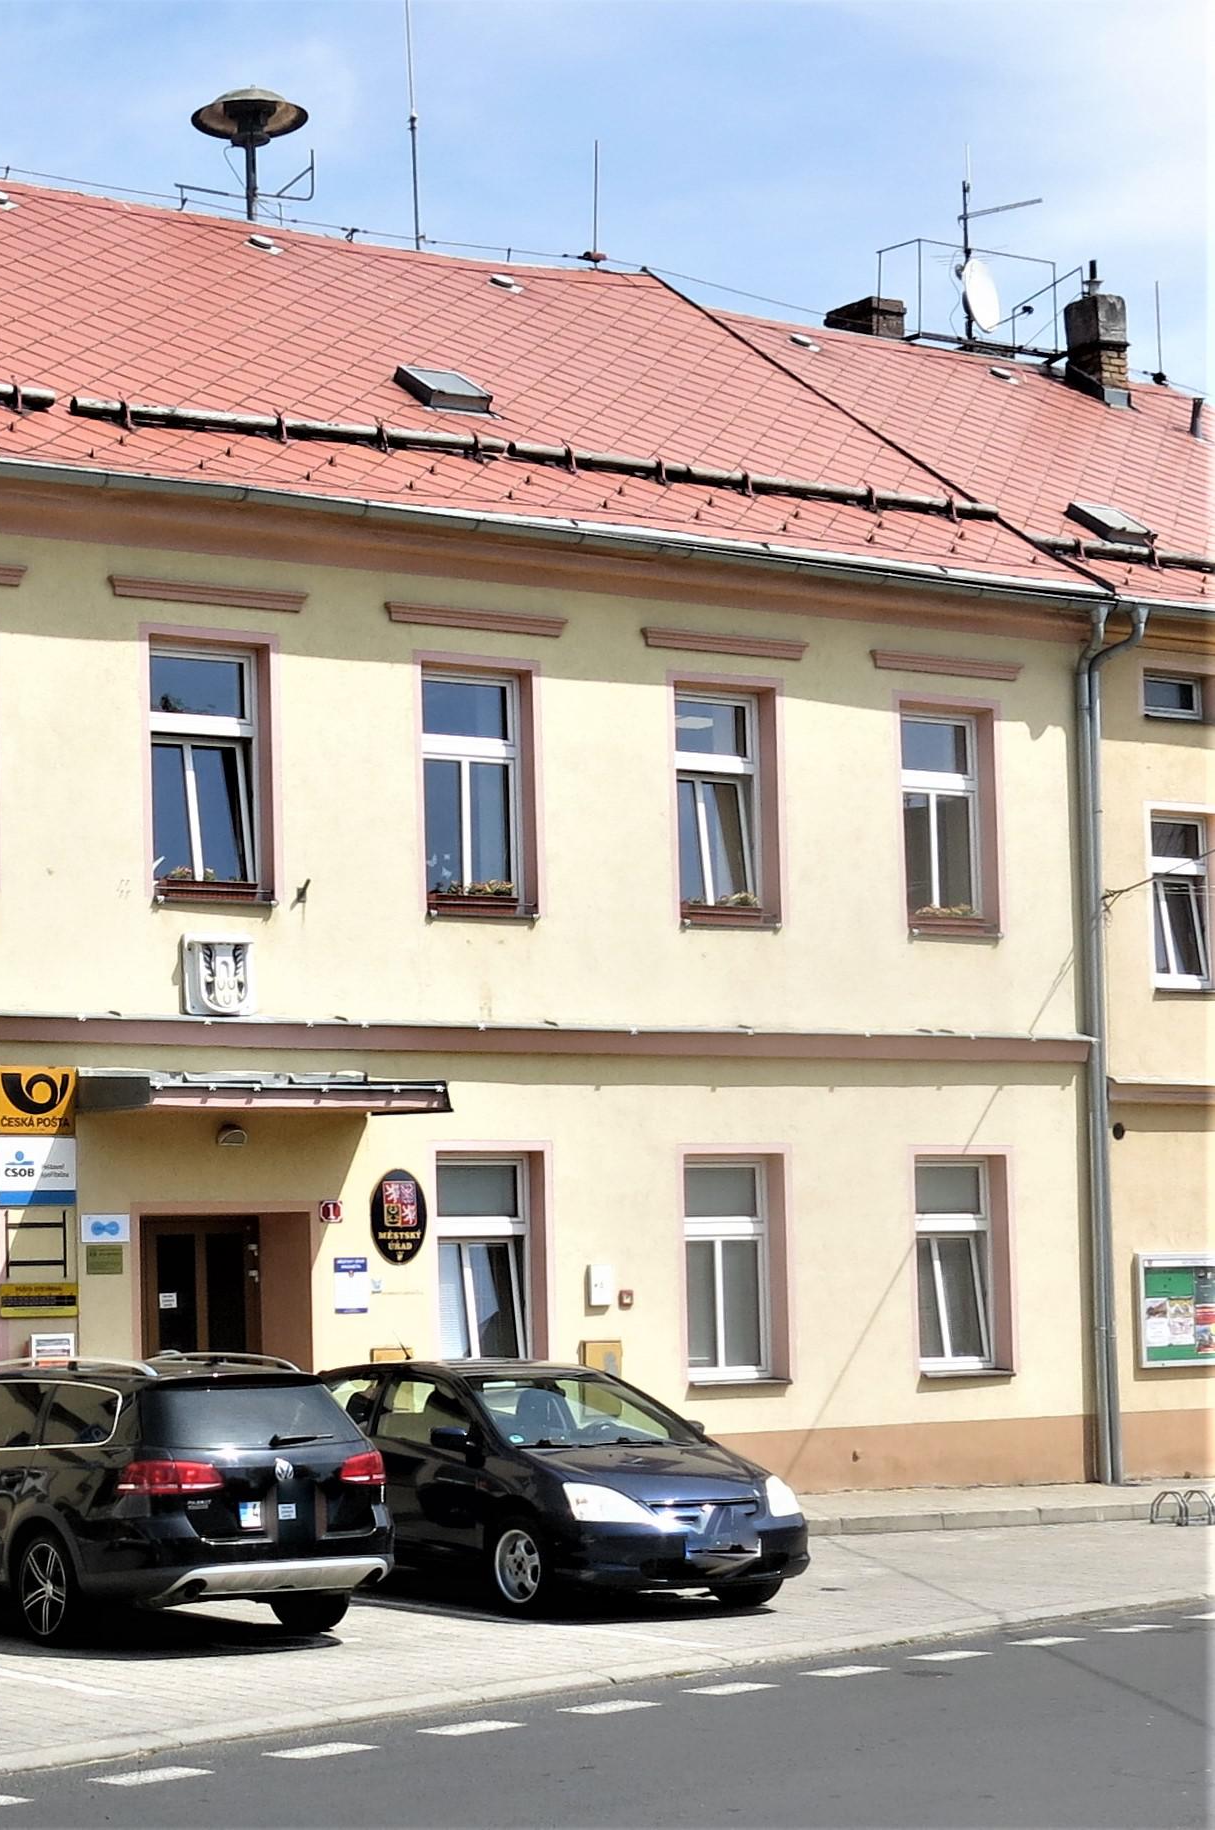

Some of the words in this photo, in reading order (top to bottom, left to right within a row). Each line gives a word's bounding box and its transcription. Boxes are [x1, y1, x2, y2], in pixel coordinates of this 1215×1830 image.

[0, 1115, 34, 1127] ČESKÁ
[36, 1115, 70, 1127] POŠTA
[327, 1203, 336, 1219] 1
[378, 1229, 422, 1240] MĚSTSKÝ
[387, 1240, 413, 1251] ÚŘAD
